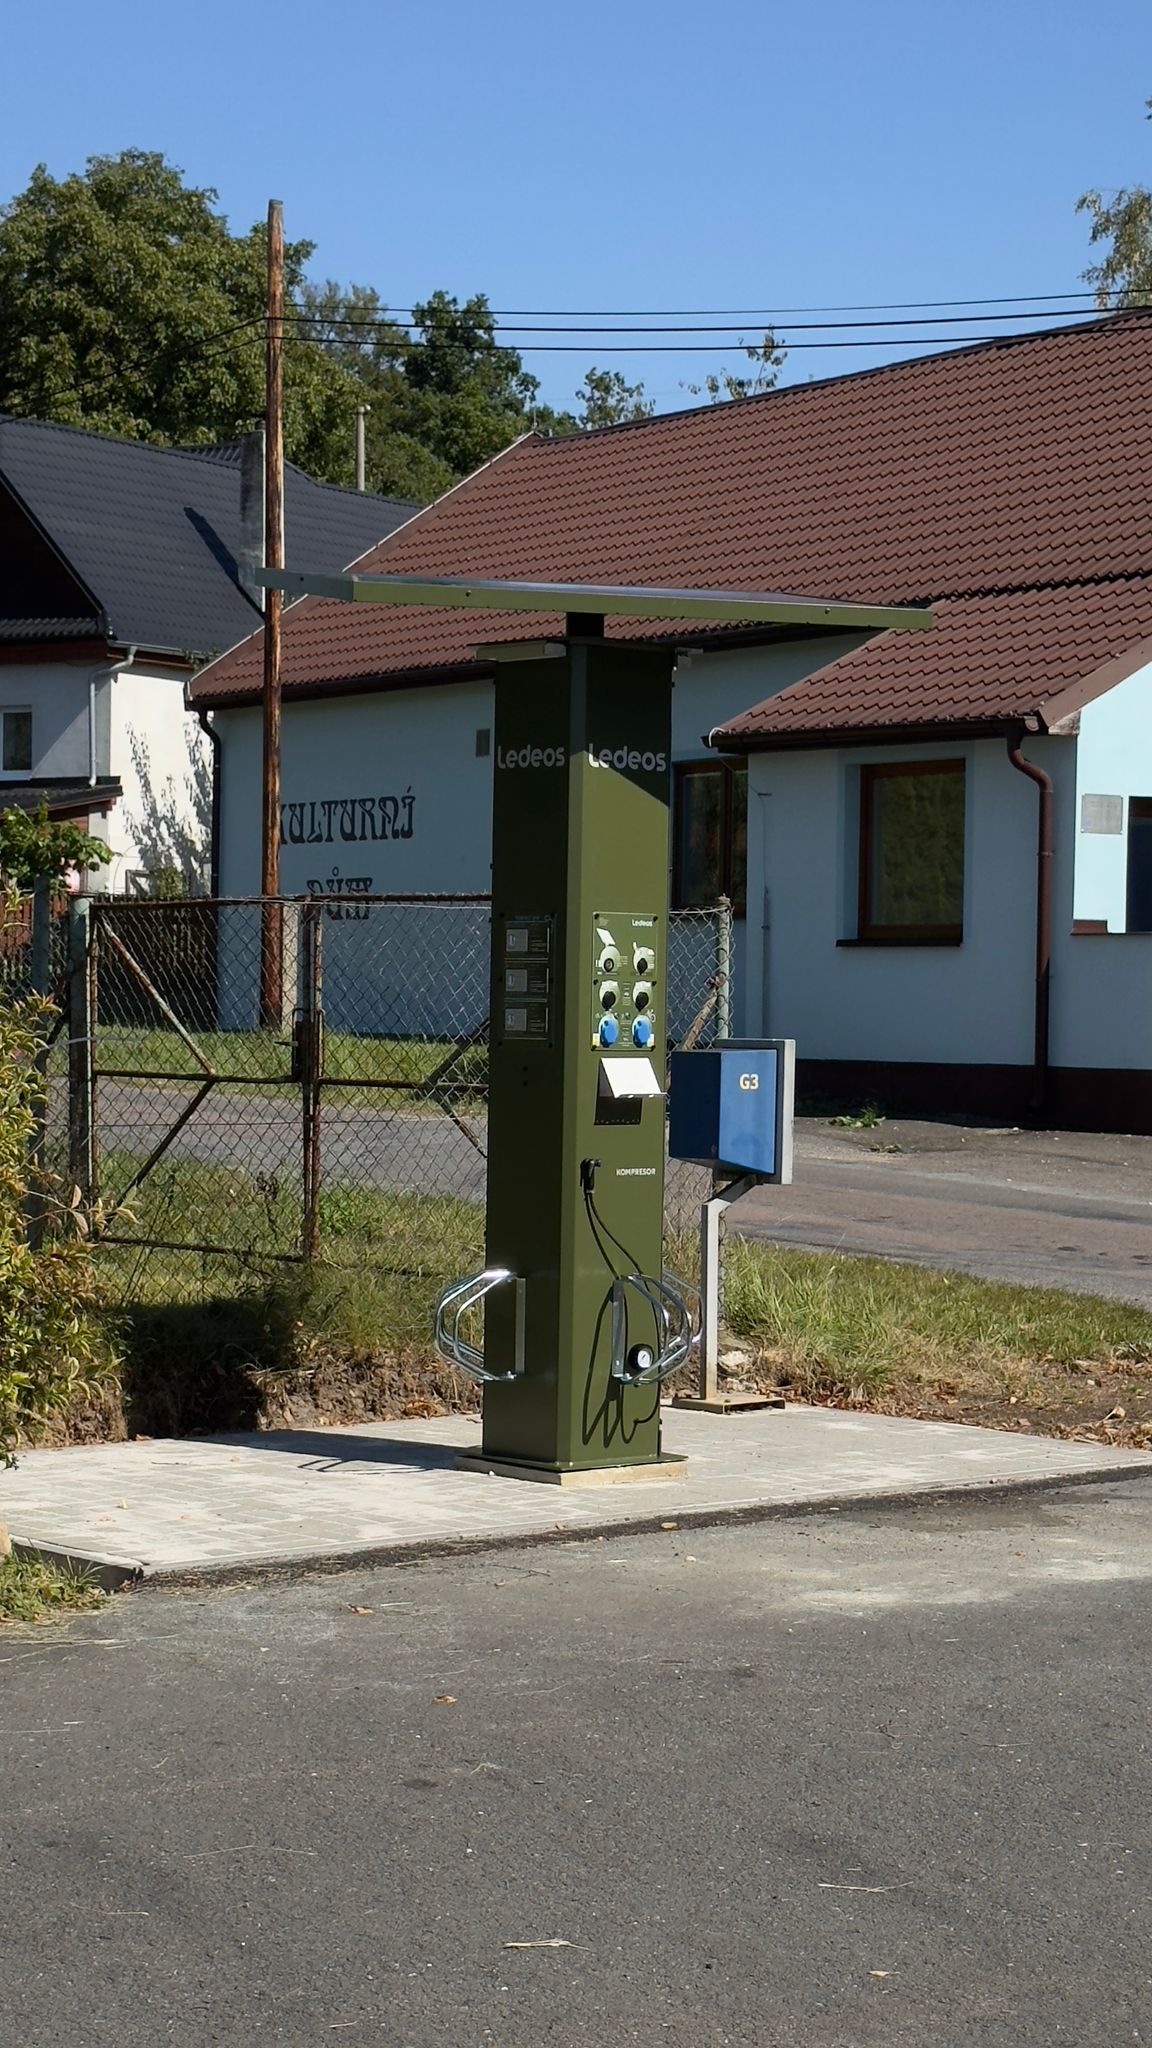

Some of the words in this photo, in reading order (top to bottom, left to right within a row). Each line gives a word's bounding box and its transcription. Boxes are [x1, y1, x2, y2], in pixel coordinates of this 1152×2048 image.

[498, 745, 565, 769] Ledeos
[588, 743, 667, 772] Ledeos
[739, 1073, 759, 1090] G3
[615, 1167, 657, 1176] KOMPRESOR
